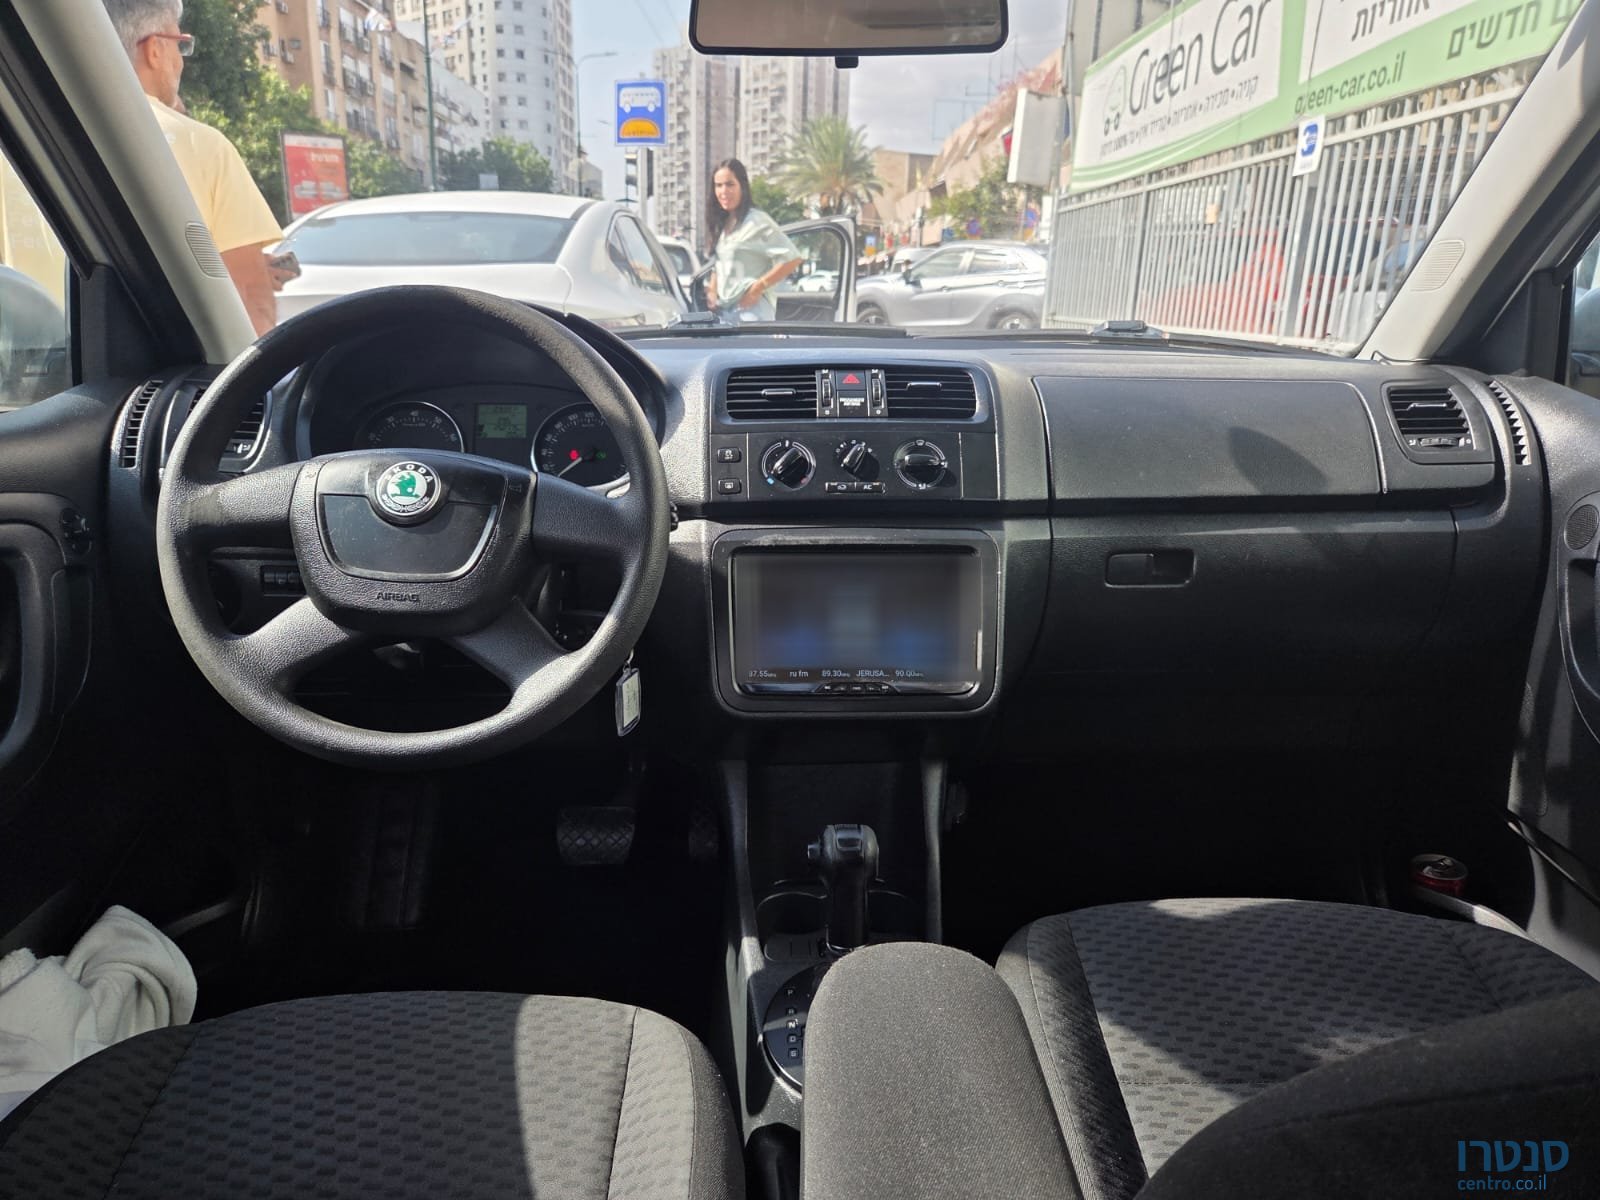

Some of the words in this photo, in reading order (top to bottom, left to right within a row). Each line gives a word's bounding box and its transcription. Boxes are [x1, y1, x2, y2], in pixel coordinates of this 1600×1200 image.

[1129, 32, 1204, 116] Green
[1211, 0, 1273, 75] Car
[1447, 0, 1542, 60] חדשים
[1294, 50, 1406, 114] green-car.co.il
[377, 592, 419, 602] AIRBAG
